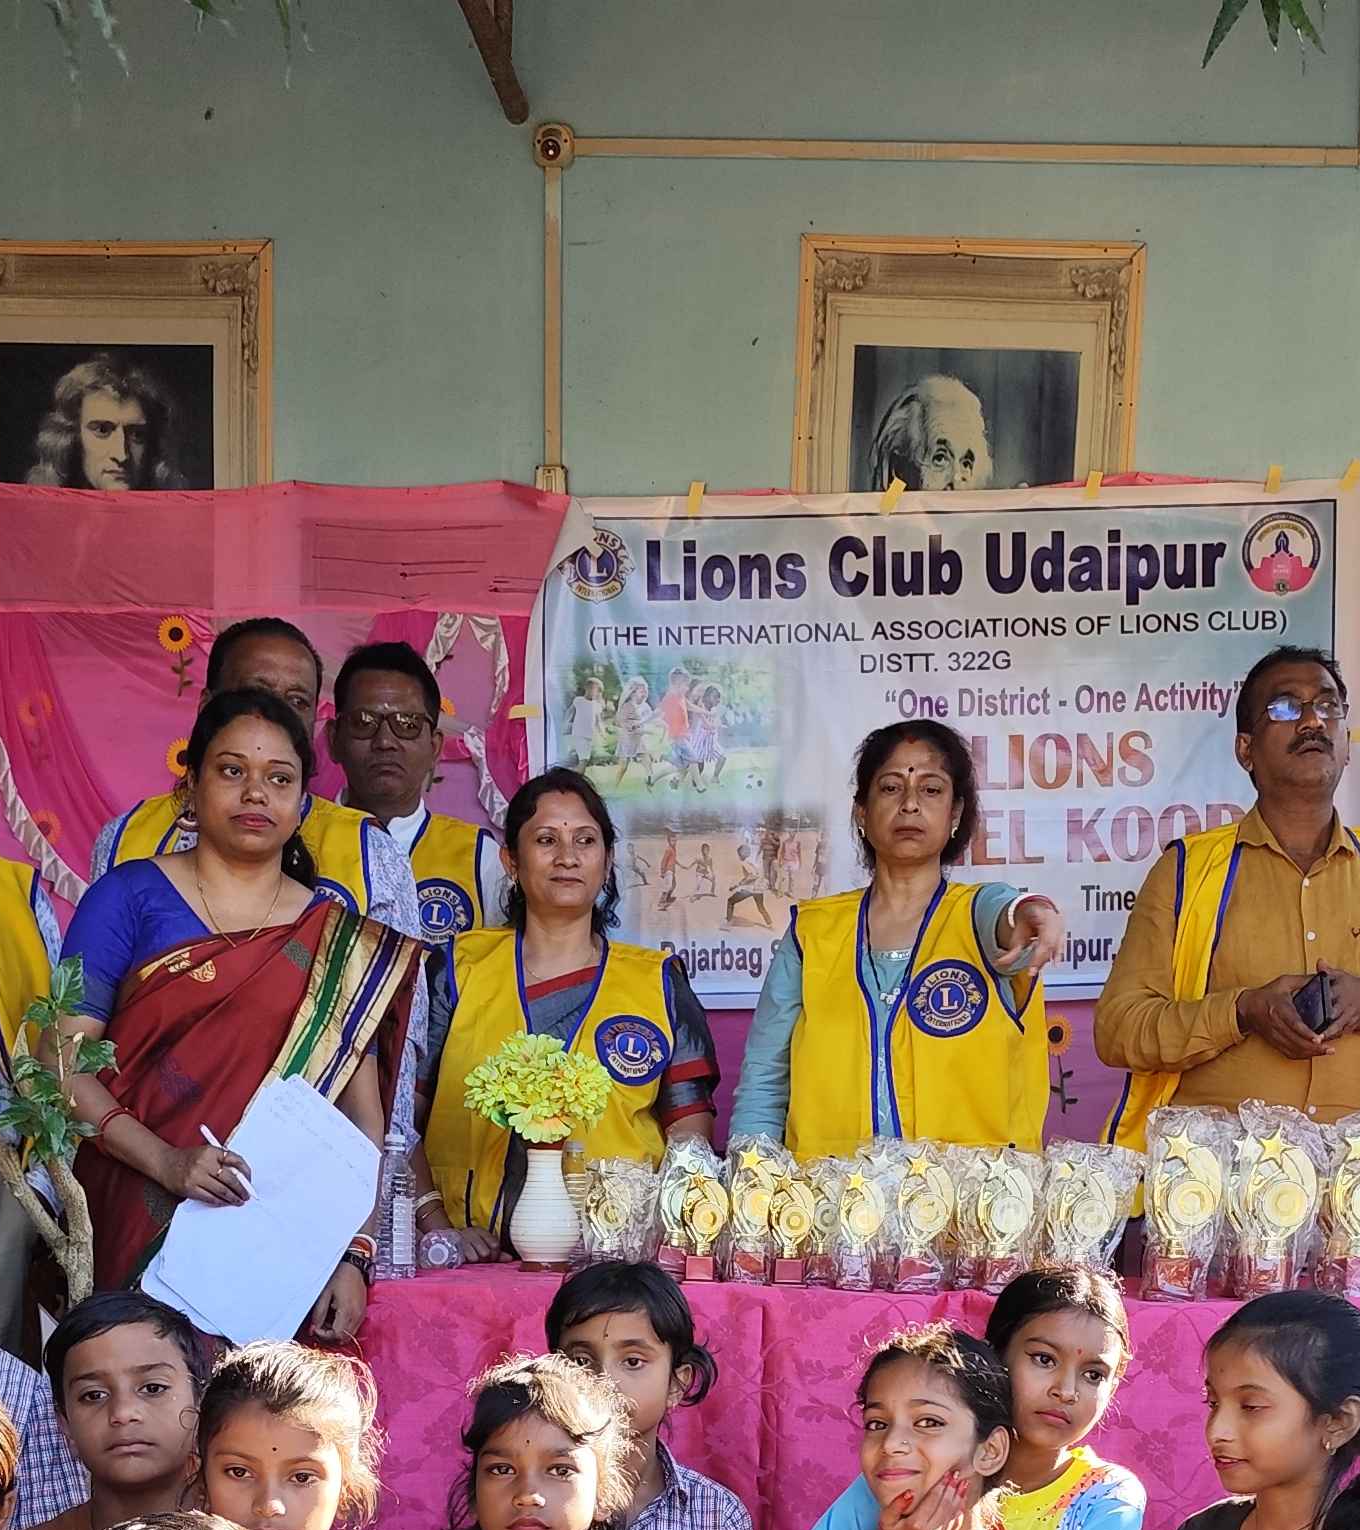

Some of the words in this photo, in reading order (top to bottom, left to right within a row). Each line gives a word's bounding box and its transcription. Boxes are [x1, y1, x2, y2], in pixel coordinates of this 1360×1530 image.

[646, 539, 807, 601] Lions
[828, 532, 963, 598] Club
[985, 529, 1227, 606] Udaipur
[589, 625, 649, 651] (THE
[658, 622, 865, 647] INTERNATIONAL
[871, 616, 1067, 641] ASSOCIATIONS
[1075, 615, 1112, 636] OF
[1120, 611, 1199, 635] LIONS
[1208, 609, 1288, 634] CLUB)
[860, 653, 939, 674] DISTT.
[947, 650, 1012, 672] 322G
[958, 687, 1051, 717] District
[1075, 685, 1127, 714] One
[971, 731, 1155, 791] LIONS
[421, 888, 459, 903] LIONS
[1080, 885, 1136, 911] Time
[429, 903, 446, 926] L
[927, 970, 969, 985] LIONS
[940, 988, 958, 1010] L
[624, 1037, 641, 1058] L
